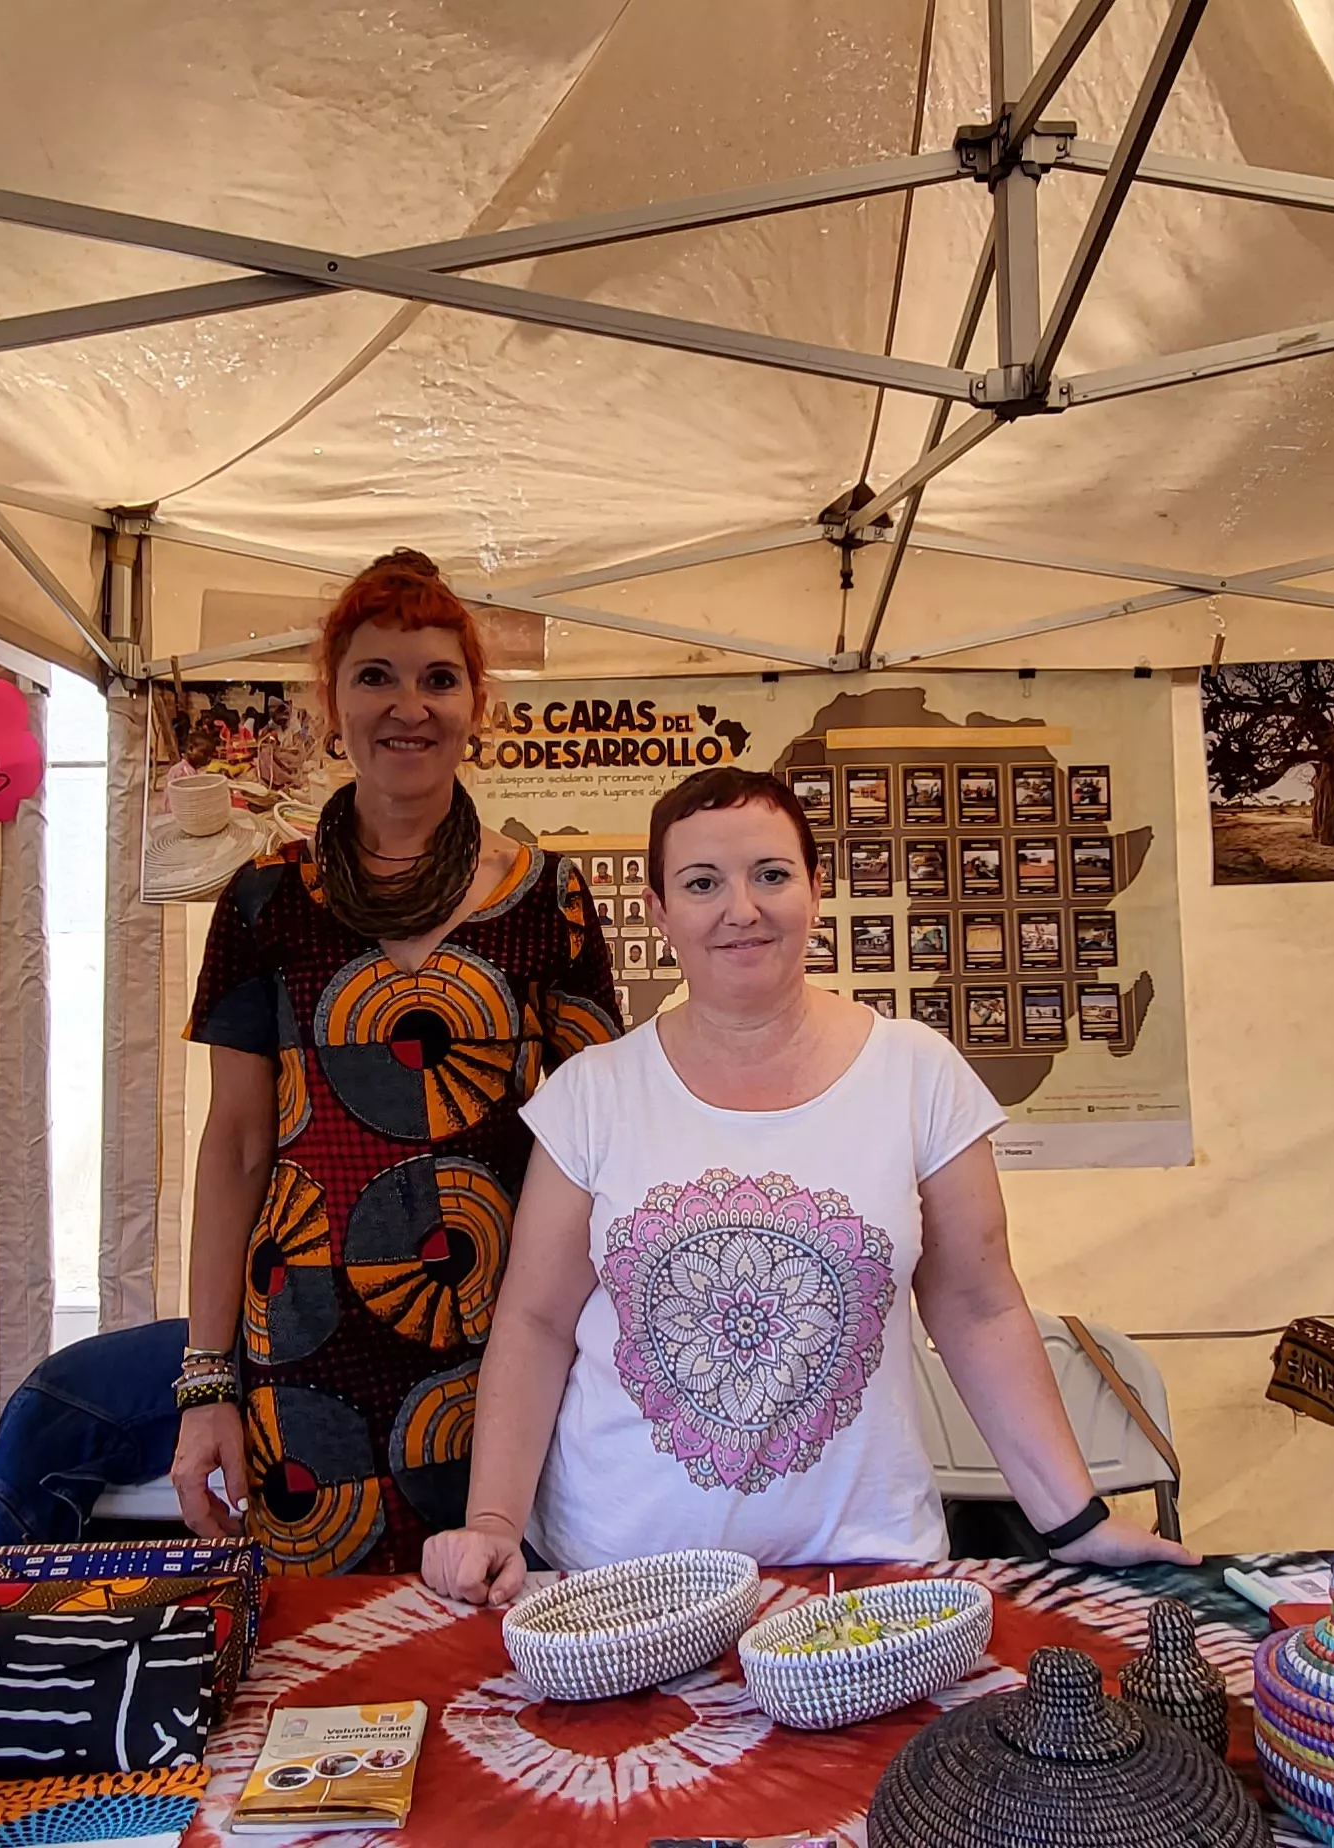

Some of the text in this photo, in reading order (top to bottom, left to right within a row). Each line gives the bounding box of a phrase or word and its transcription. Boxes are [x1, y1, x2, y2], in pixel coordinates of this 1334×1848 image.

[542, 699, 657, 734] CARAS
[662, 714, 695, 734] DEL
[473, 736, 723, 771] CODESARROLLO
[597, 773, 655, 786] promueve
[603, 787, 645, 802] lugares
